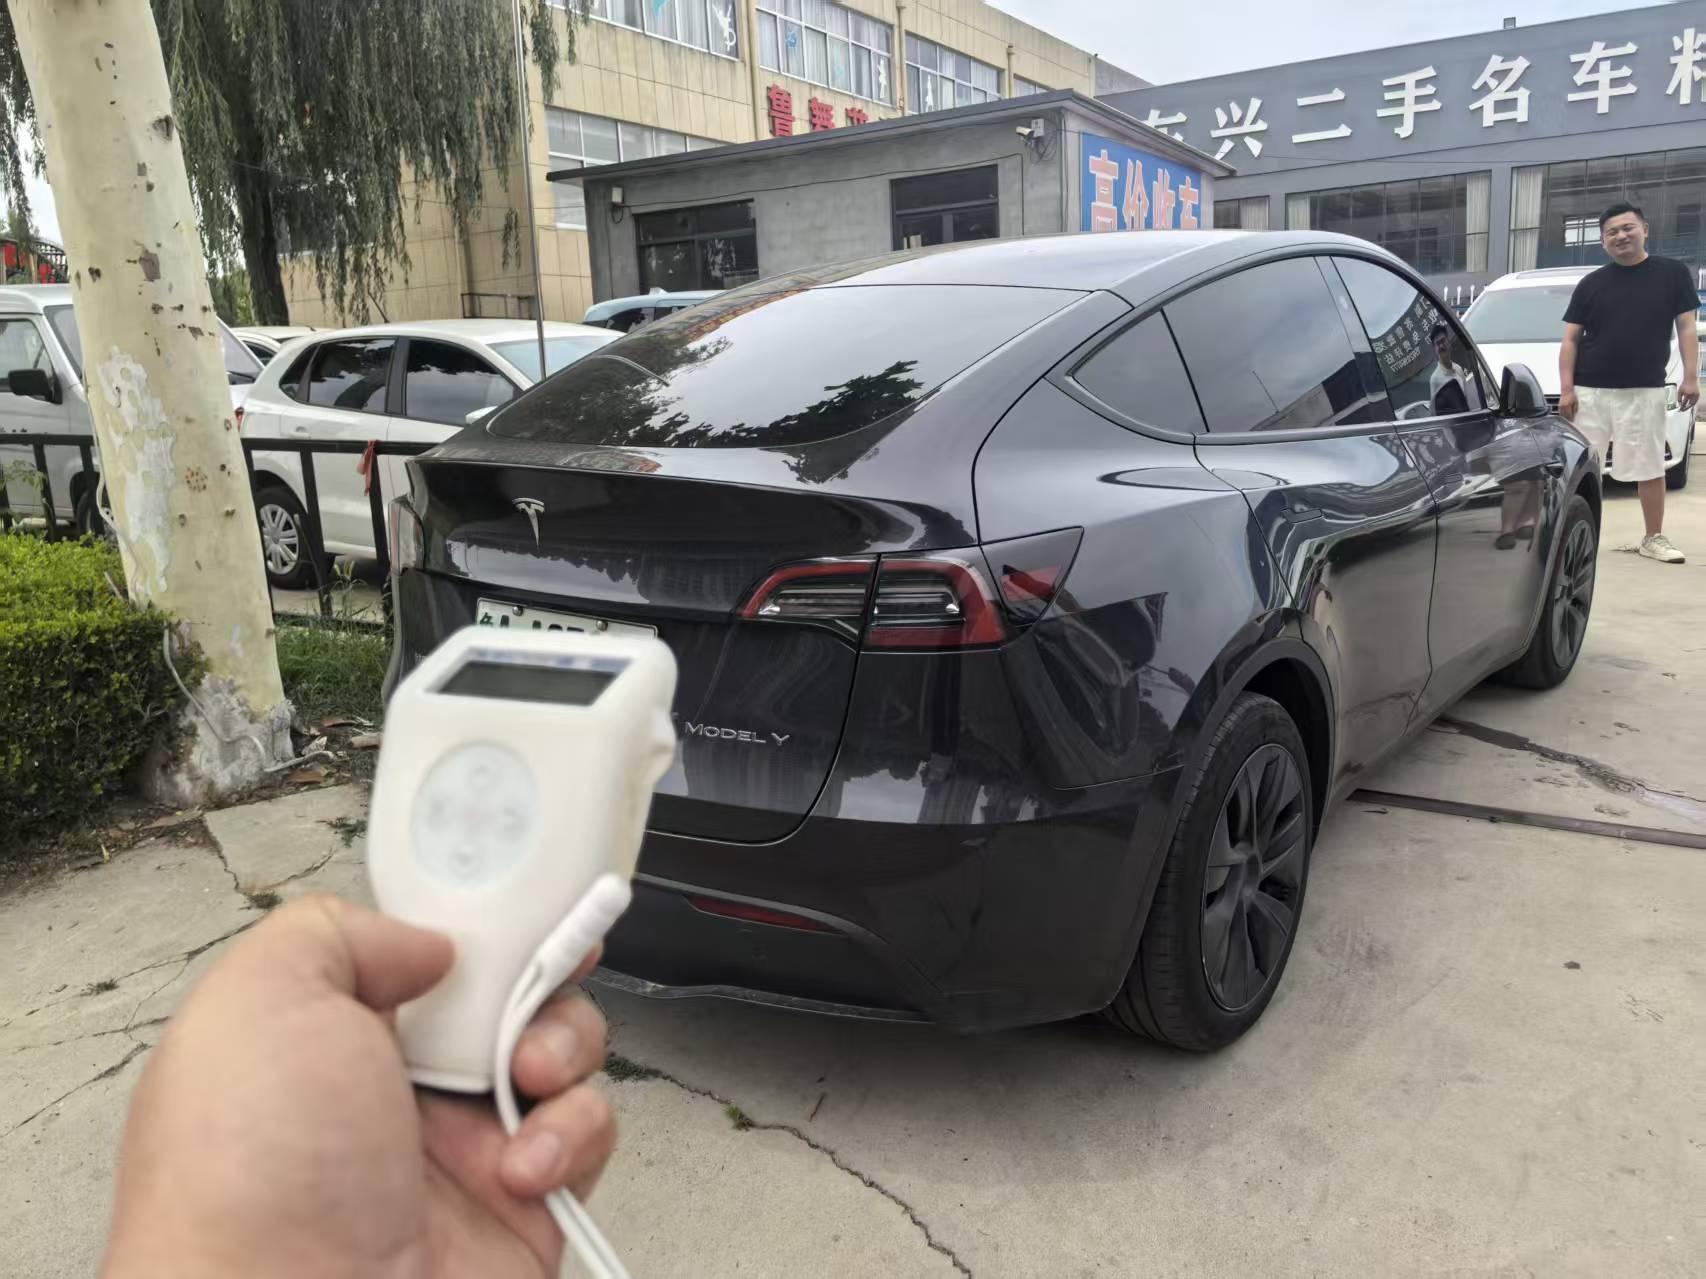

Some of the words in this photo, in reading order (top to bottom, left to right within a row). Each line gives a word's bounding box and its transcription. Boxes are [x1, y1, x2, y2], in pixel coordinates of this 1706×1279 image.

[1089, 149, 1199, 232] 高价收车
[684, 721, 767, 743] MODEL
[771, 732, 790, 746] Y
